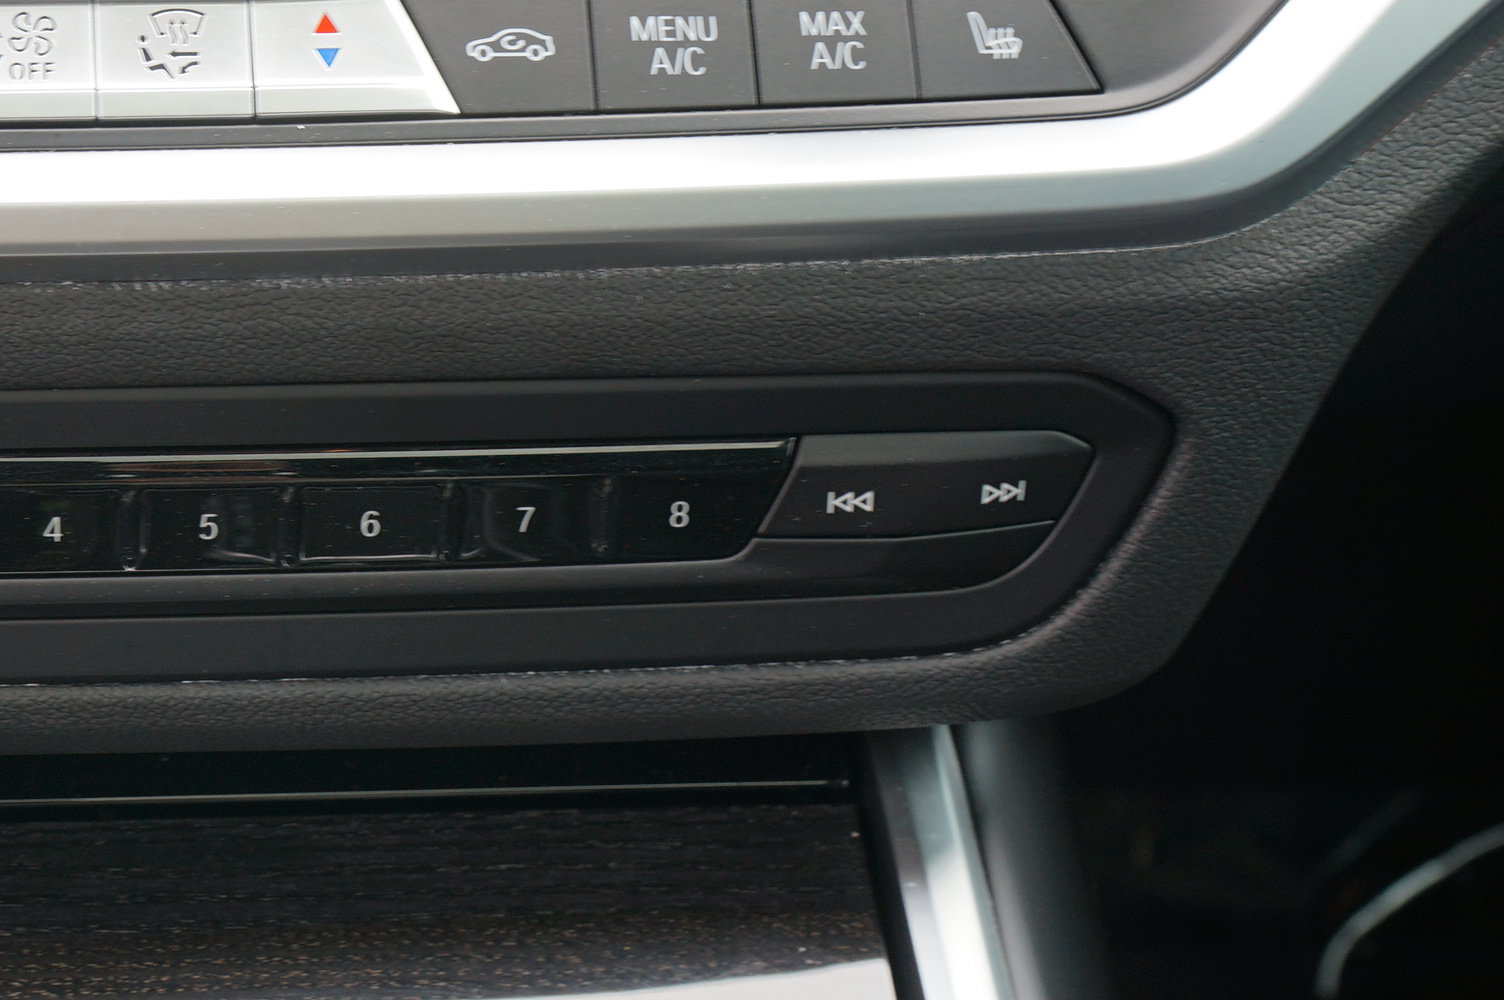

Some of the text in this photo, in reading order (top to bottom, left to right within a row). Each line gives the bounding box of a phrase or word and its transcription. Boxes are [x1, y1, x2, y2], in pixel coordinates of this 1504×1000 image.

[629, 15, 717, 42] MENU
[799, 10, 867, 36] MAX
[651, 47, 707, 76] A/C
[810, 41, 867, 70] A/C
[9, 61, 55, 81] OFF
[198, 513, 219, 541] 5
[359, 510, 382, 538] 6
[517, 506, 537, 534] 7
[668, 501, 691, 529] 8
[41, 516, 65, 543] 4
